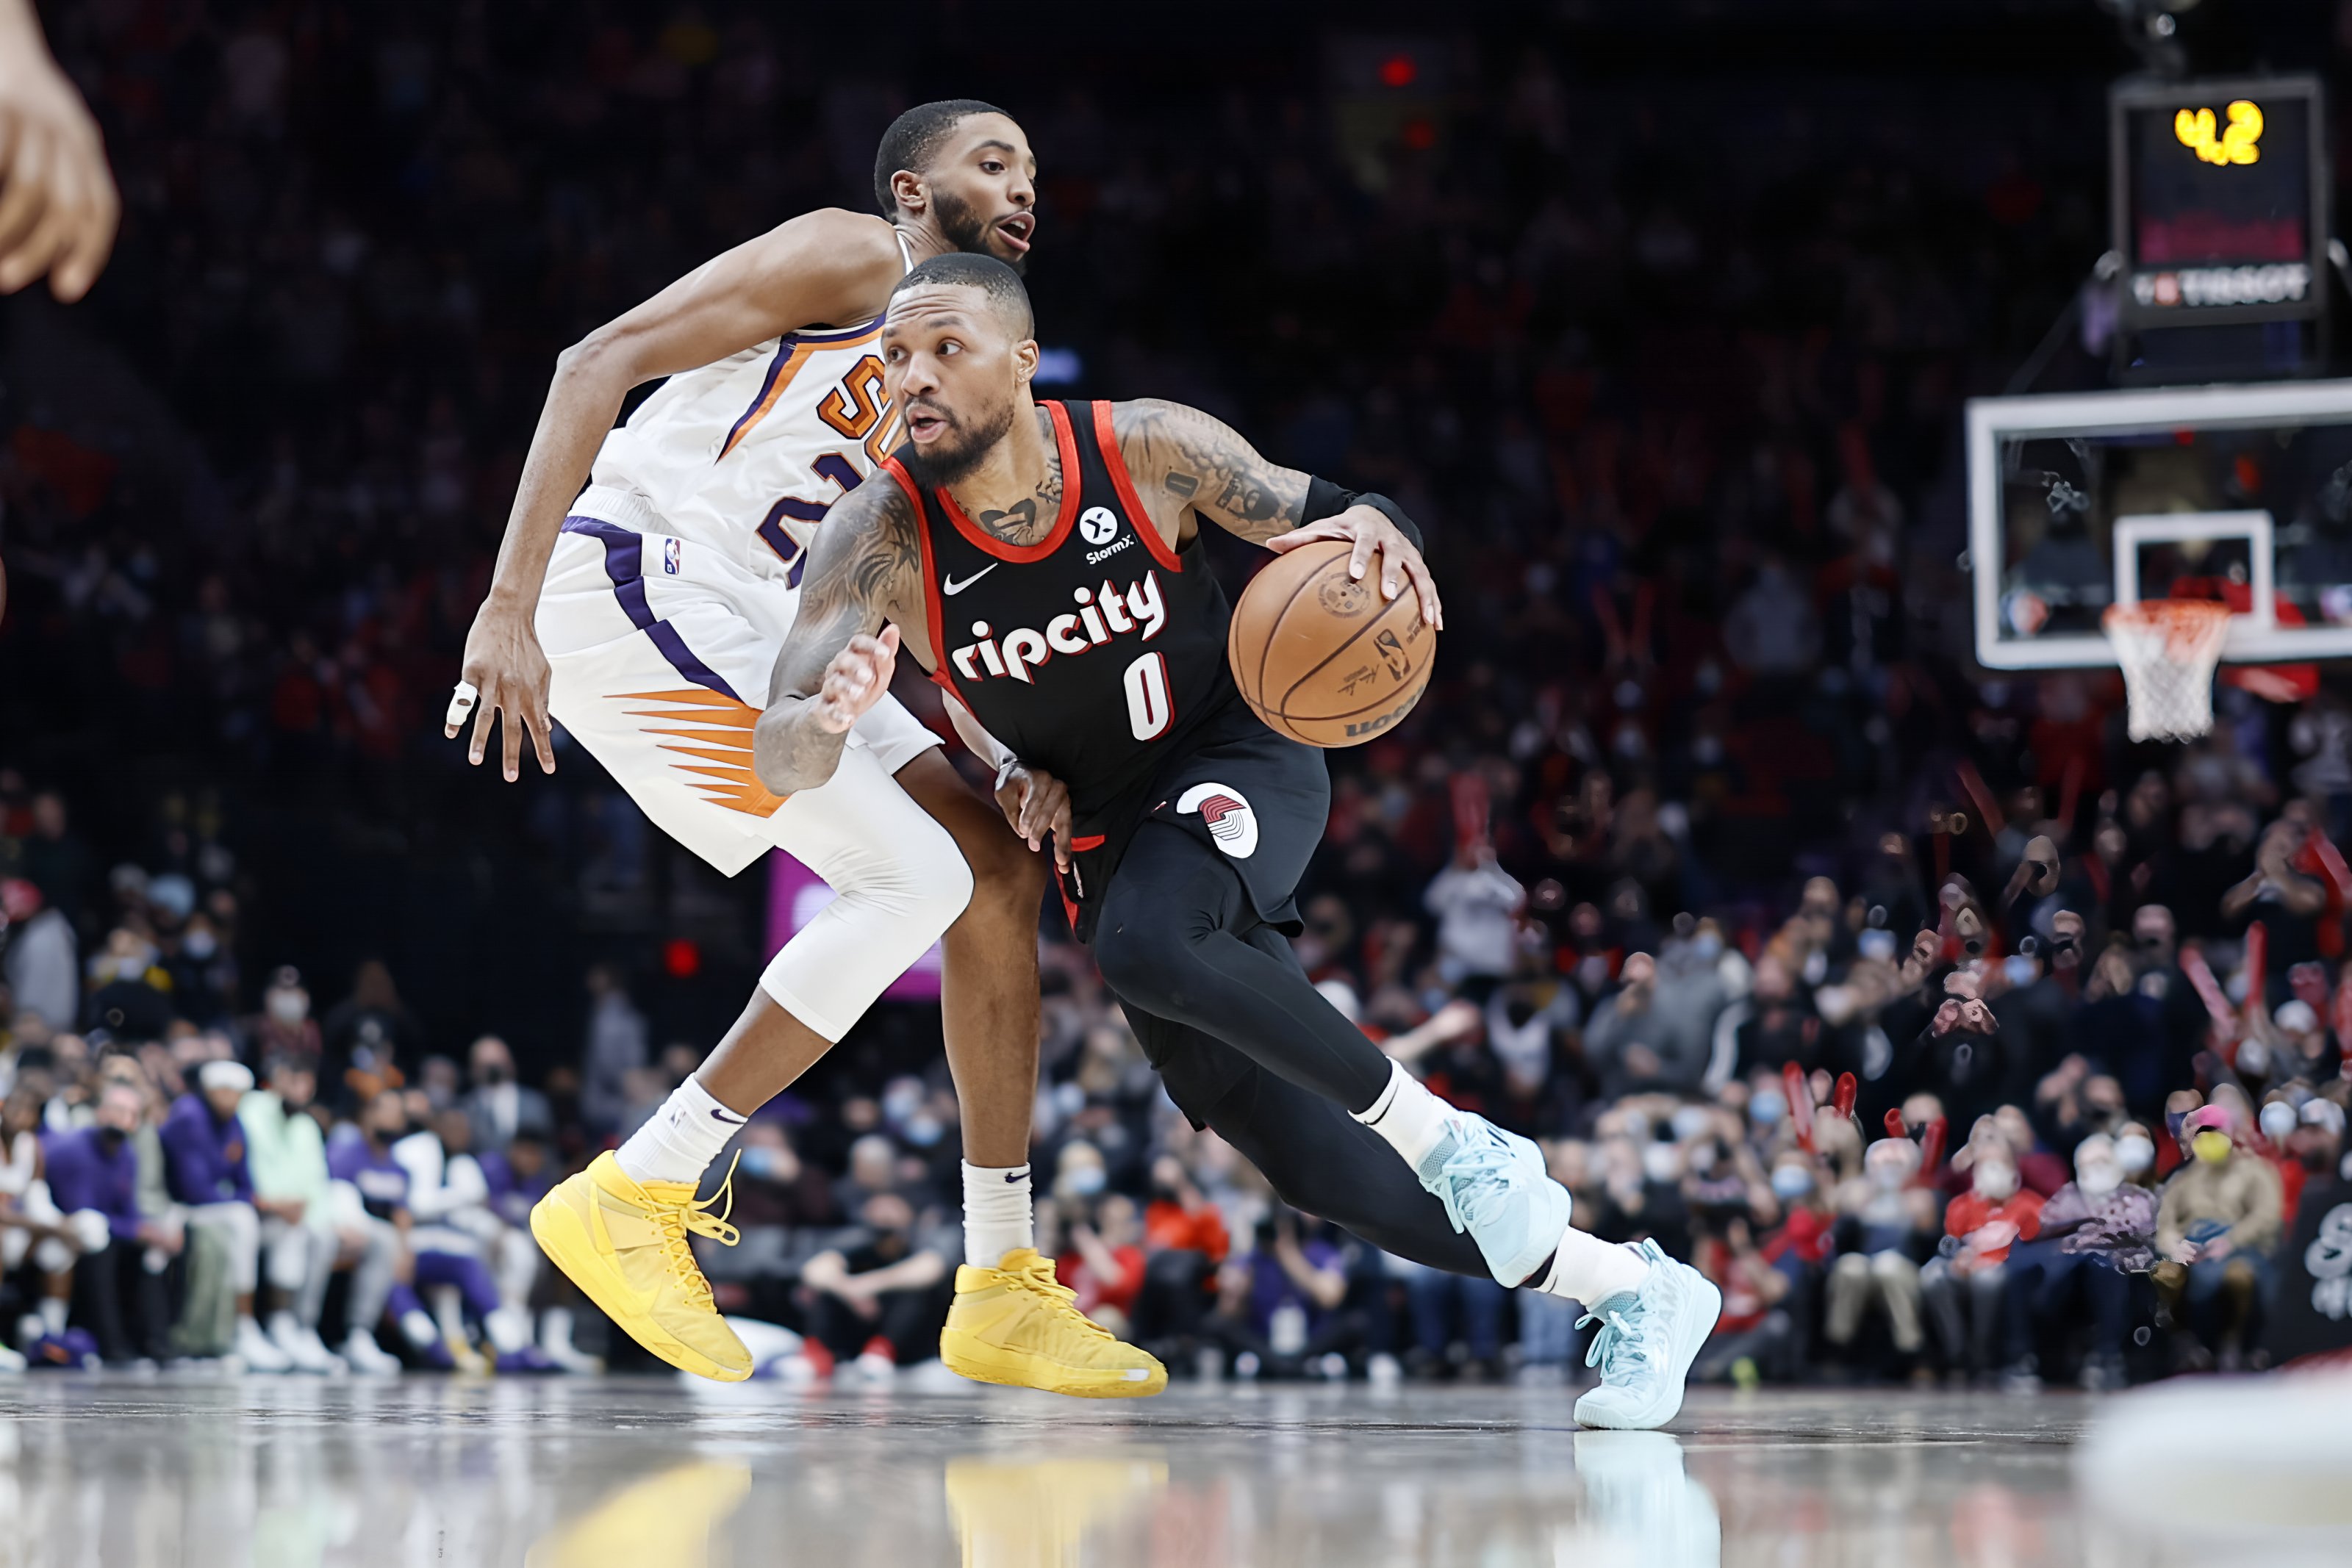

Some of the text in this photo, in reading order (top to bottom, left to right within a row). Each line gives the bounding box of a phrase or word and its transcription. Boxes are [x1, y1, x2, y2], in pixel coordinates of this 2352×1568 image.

[755, 452, 865, 591] 2
[1086, 534, 1135, 564] StormX
[952, 570, 1168, 685] ripcity
[1124, 651, 1175, 741] 0
